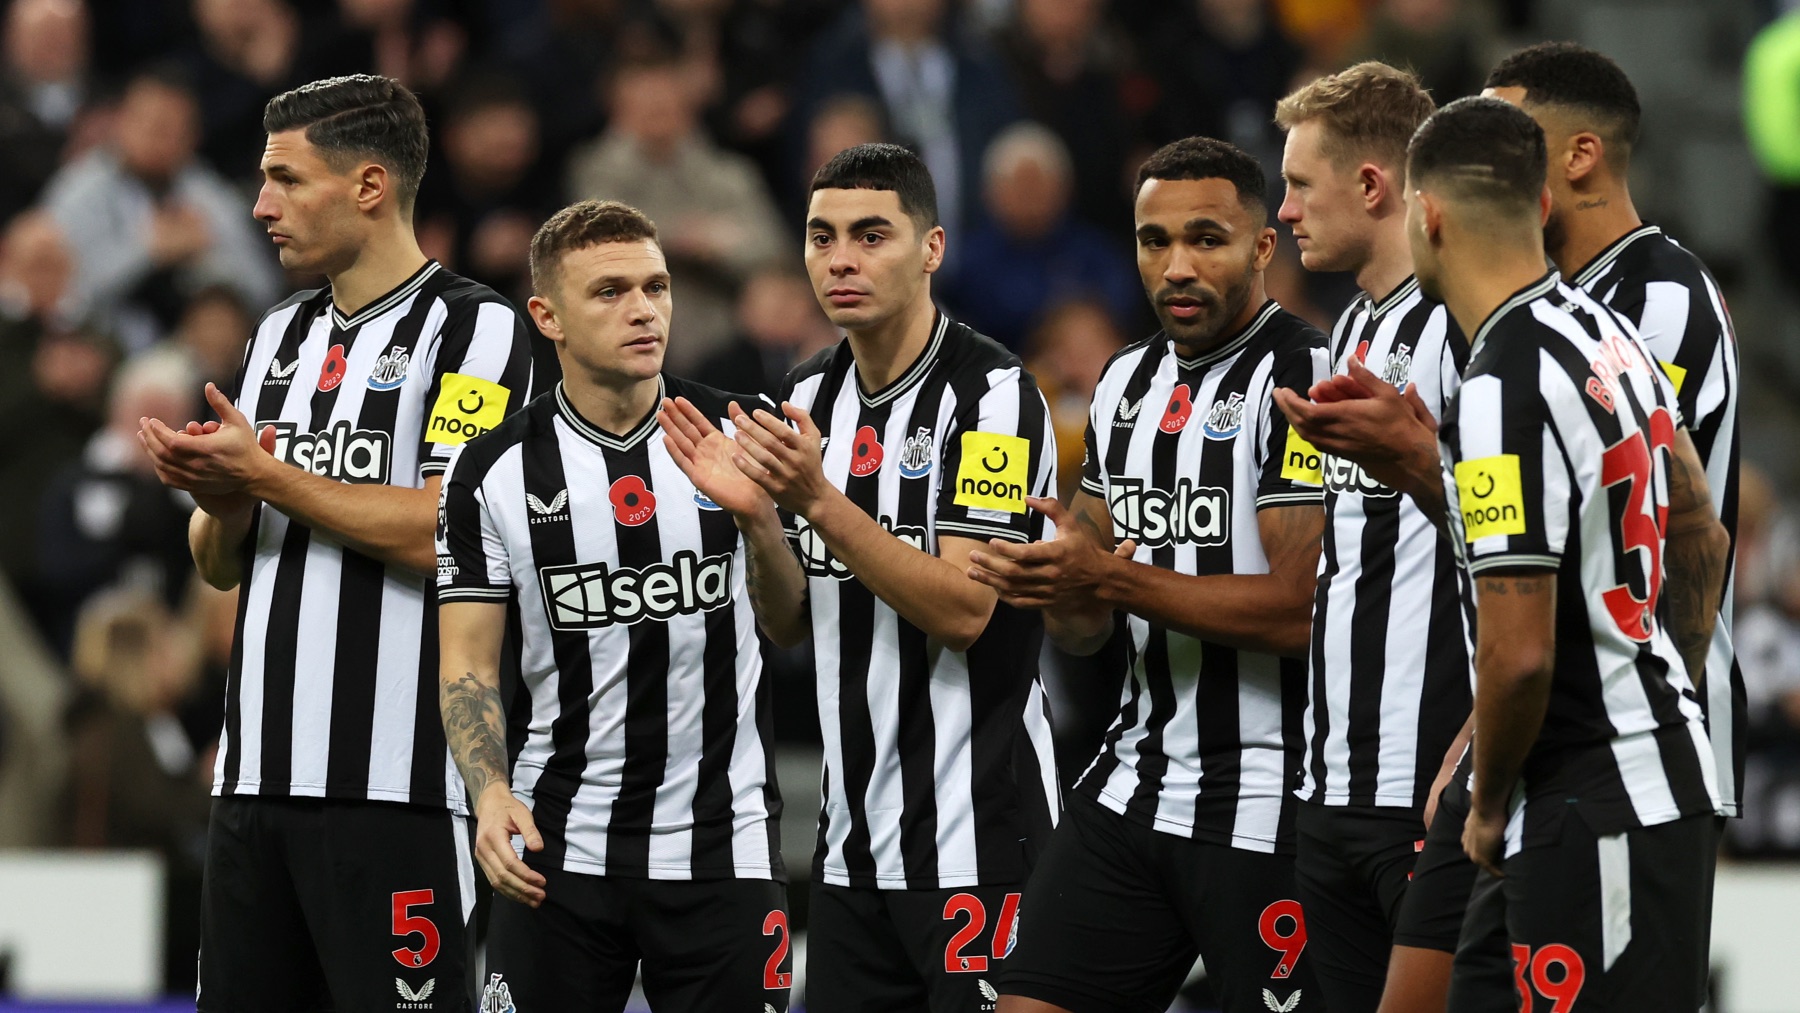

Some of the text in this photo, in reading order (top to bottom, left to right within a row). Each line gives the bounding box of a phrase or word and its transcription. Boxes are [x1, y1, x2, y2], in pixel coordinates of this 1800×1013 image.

[323, 373, 342, 388] 2023
[1166, 416, 1186, 429] 2023
[293, 426, 383, 479] sela
[1289, 451, 1321, 471] no
[855, 457, 877, 472] 2023
[962, 478, 1022, 500] noon
[530, 514, 570, 525] CASTORE
[628, 506, 651, 522] 2023
[1143, 484, 1221, 541] sla
[1465, 503, 1518, 529] noon
[610, 557, 728, 617] sela
[391, 888, 441, 968] 5
[1258, 899, 1308, 978] 9
[762, 909, 792, 989] 2
[396, 1002, 433, 1010] CASTORE
